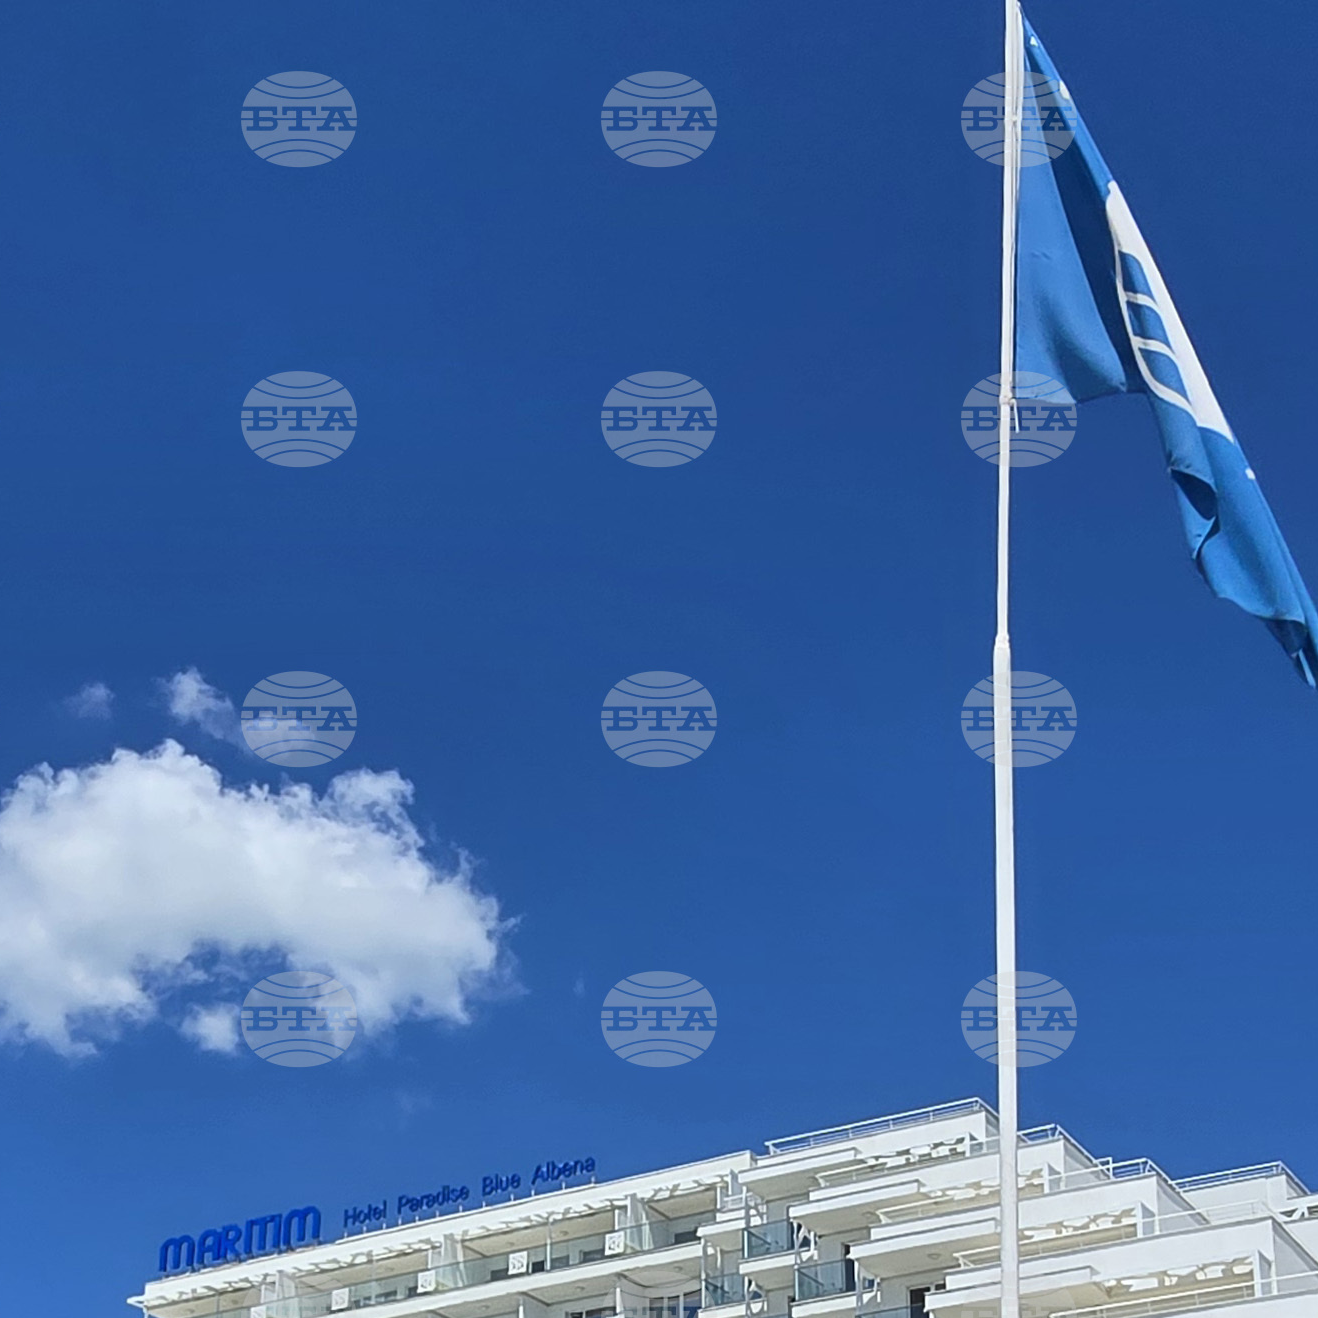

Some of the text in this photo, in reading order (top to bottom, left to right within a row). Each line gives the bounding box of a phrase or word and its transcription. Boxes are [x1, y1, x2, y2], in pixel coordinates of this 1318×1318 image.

[343, 1156, 596, 1228] Hotel Paradise Blue Albena
[159, 1205, 321, 1273] MARITIM
